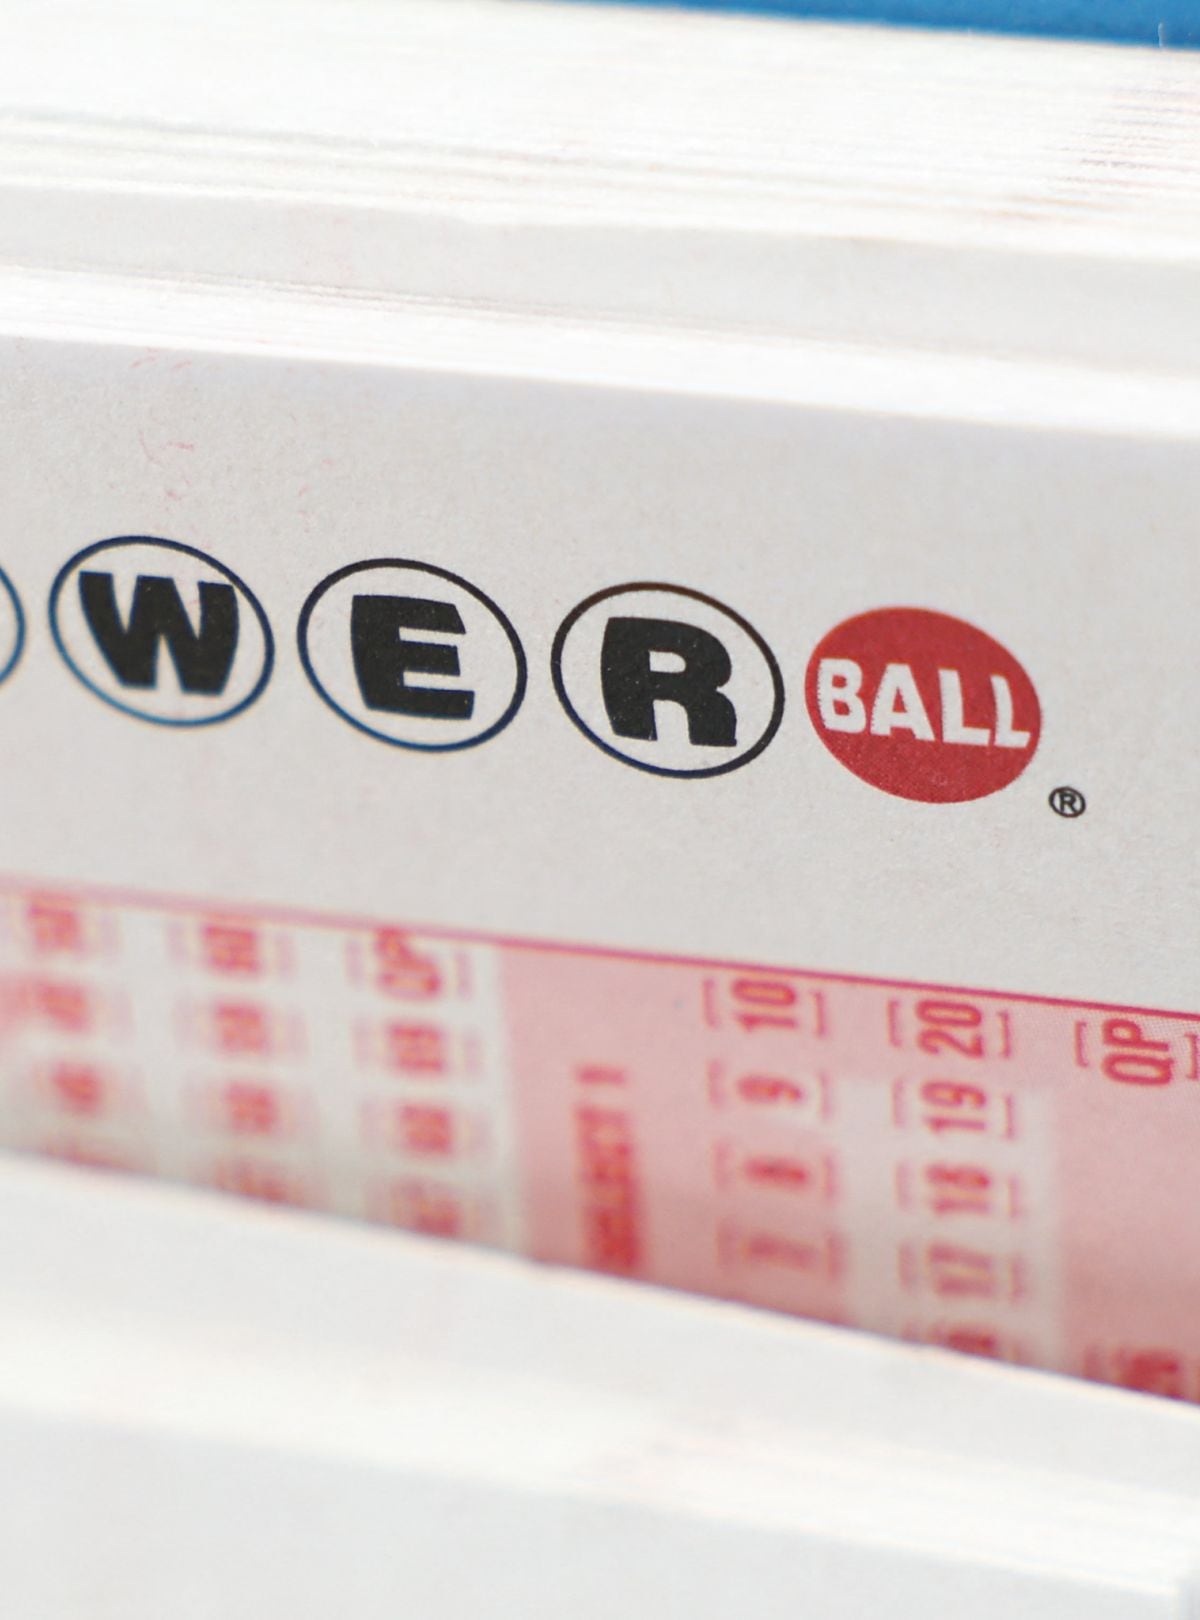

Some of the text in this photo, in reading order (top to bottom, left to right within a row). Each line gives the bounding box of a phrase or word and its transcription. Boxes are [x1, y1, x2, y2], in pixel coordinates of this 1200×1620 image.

[730, 976, 798, 1034] 10
[914, 999, 986, 1061] 20
[1100, 1017, 1176, 1089] QP
[736, 1074, 803, 1104] 9
[919, 1078, 987, 1136] 19
[924, 1160, 992, 1217] 18
